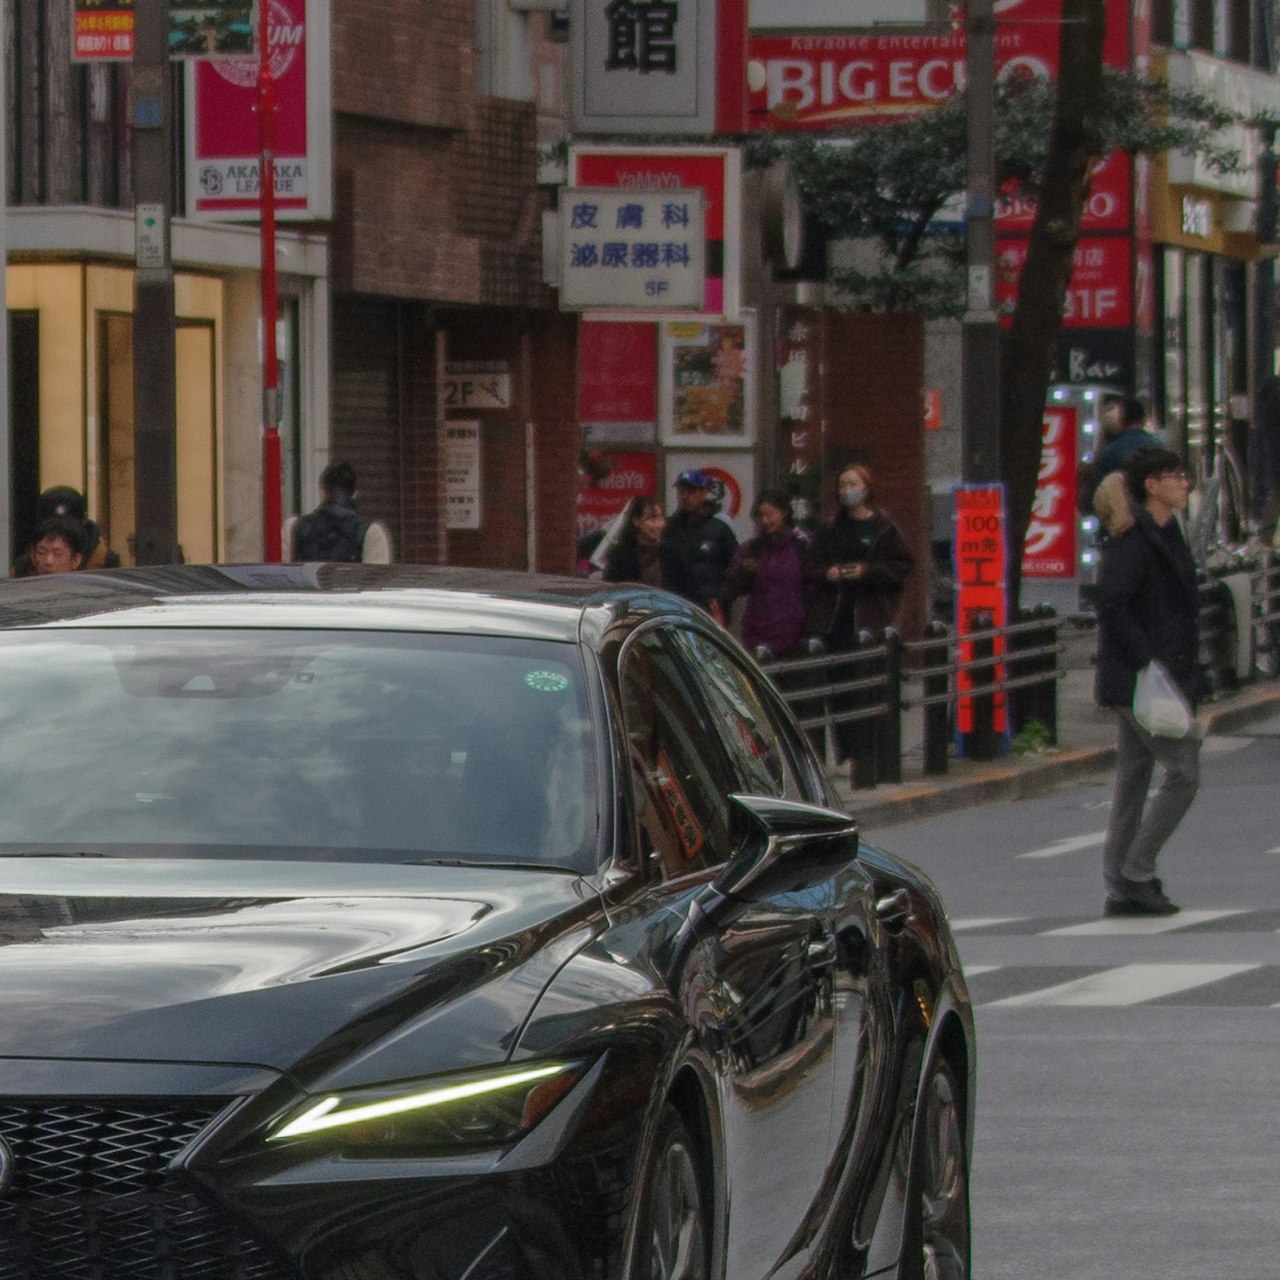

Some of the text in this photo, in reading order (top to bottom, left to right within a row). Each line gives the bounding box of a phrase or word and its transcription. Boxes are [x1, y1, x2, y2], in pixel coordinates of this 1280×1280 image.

[604, 0, 677, 74] 館
[764, 58, 875, 111] BIG
[226, 165, 303, 179] AKAAKA
[236, 178, 294, 193] LEAUE
[570, 242, 690, 268] 泌尿器科
